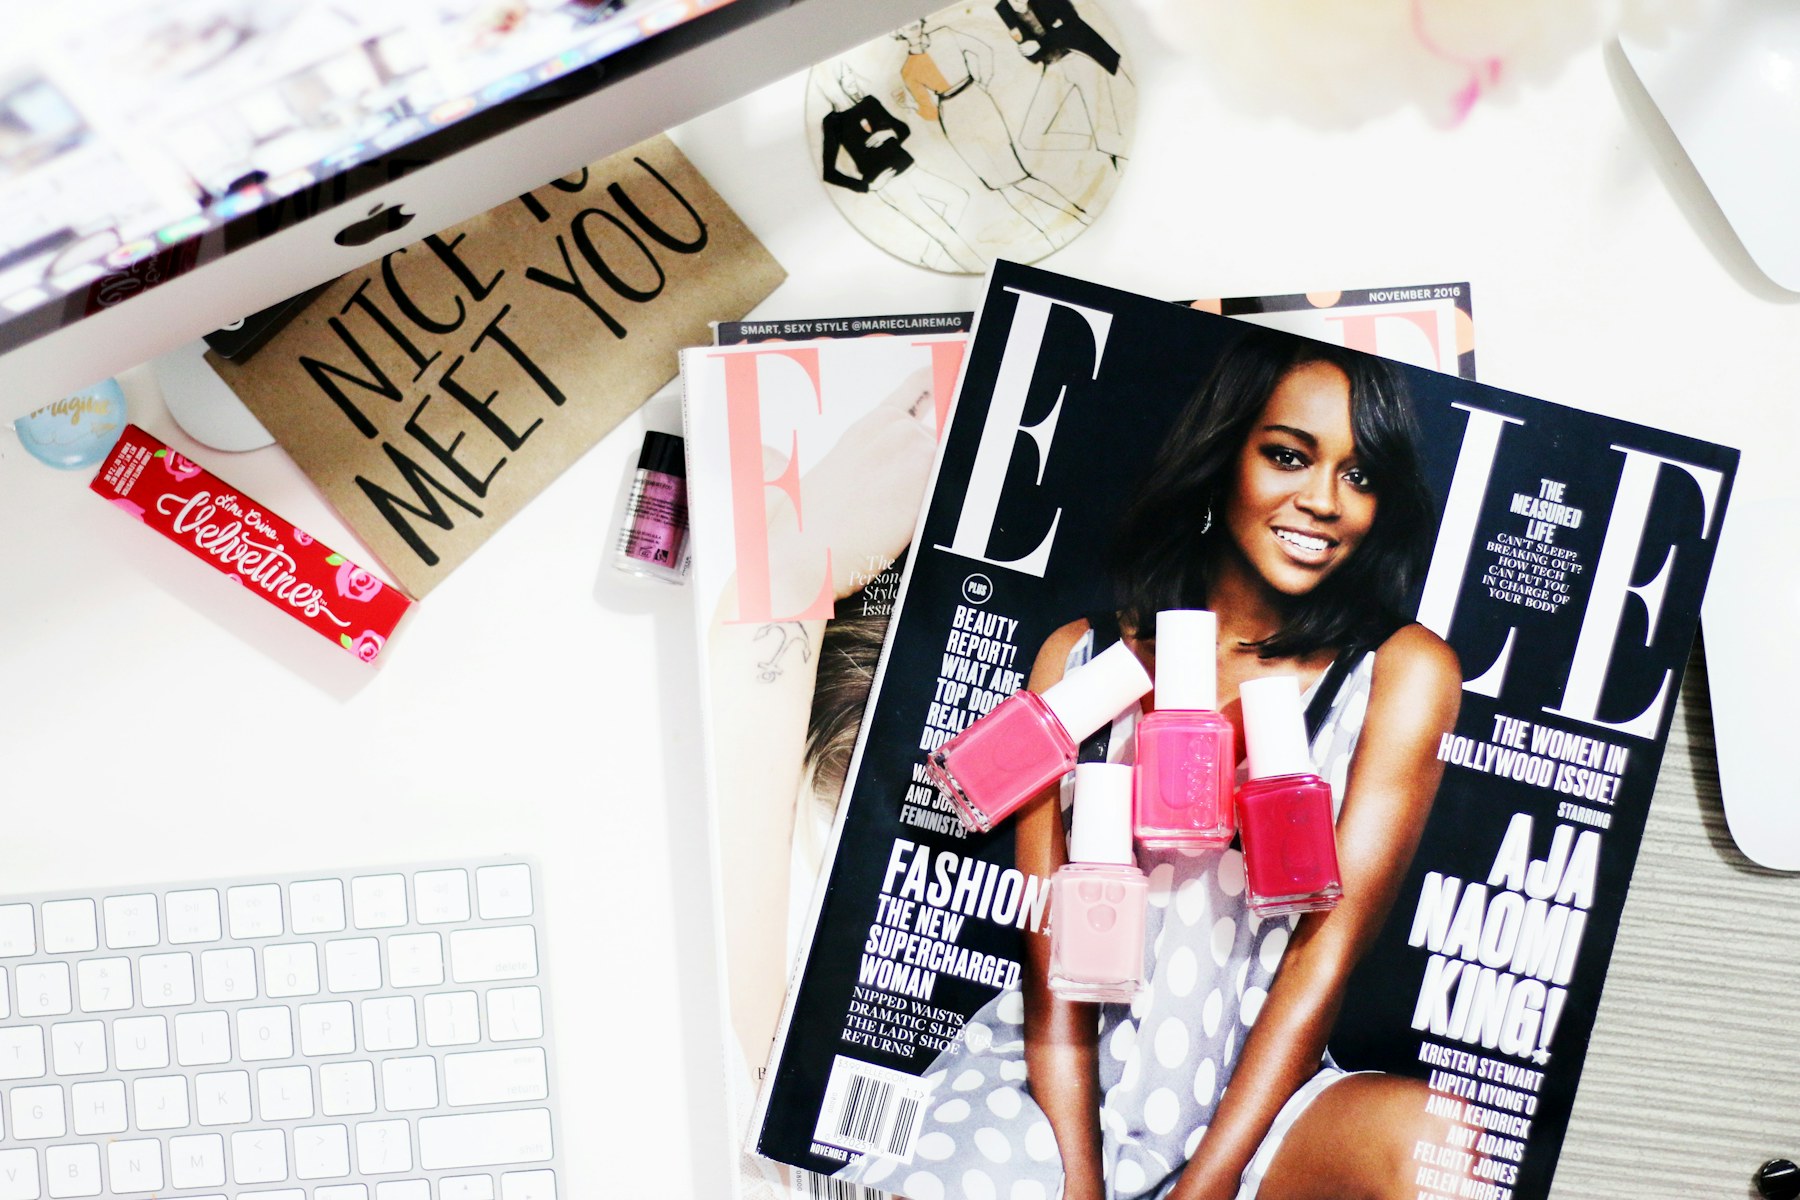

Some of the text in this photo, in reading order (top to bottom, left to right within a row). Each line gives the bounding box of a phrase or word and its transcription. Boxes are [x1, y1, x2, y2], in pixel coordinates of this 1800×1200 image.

[1369, 287, 1460, 302] NOVEMBER 2016
[300, 232, 504, 438] NICE
[741, 317, 962, 335] SMART, SEXY STYLE @MARIECLAIREMAG
[355, 157, 708, 566] MEET YOU
[1538, 478, 1566, 503] THE
[1510, 493, 1583, 529] MEASURED
[1526, 518, 1556, 544] LIFE
[156, 491, 351, 627] Velvetines
[1486, 542, 1582, 574] BREAKING OUT?
[1497, 532, 1578, 562] CAN'T SLEEP?
[866, 555, 895, 570] The
[1498, 556, 1565, 582] HOW TECH
[968, 582, 987, 596] PLUS
[1482, 574, 1570, 605] IN CHARGE OF
[1488, 565, 1570, 594] CAN PUT YOU
[1488, 588, 1559, 614] YOUR BODY
[952, 605, 1019, 642] BEAUTY
[946, 629, 1017, 668] REPORT!
[940, 653, 1024, 695] WHAT ARE
[934, 677, 968, 706] TOP
[1492, 714, 1629, 776] THE WOMEN IN
[1436, 732, 1622, 806] HOLLYWOOD ISSUE!
[904, 784, 932, 806] AND
[900, 804, 968, 839] FEMINISTS!
[1557, 802, 1612, 830] STARRING
[1486, 812, 1601, 910] AJA
[874, 894, 965, 943] THE NEW
[1408, 870, 1588, 986] NAOMI
[495, 961, 528, 973] delete
[865, 924, 1021, 991] SUPERCHARGED
[163, 982, 173, 997] 8
[225, 978, 234, 992] 9
[858, 954, 936, 1000] WOMAN
[39, 993, 49, 1007] 6
[102, 987, 110, 1000] 7
[852, 986, 966, 1028] NIPPED WAISTS,
[848, 1001, 926, 1030] DRAMATIC
[1410, 954, 1567, 1066] KING!
[259, 1026, 270, 1041] O
[321, 1022, 331, 1035] P
[846, 1015, 960, 1056] THE LADY SHOE
[12, 1046, 21, 1059] T
[74, 1042, 83, 1054] Y
[135, 1037, 146, 1051] U
[841, 1029, 916, 1058] RETURNS!
[1418, 1042, 1544, 1092] KRISTEN STEWART
[157, 1096, 165, 1110] J
[218, 1092, 227, 1104] K
[281, 1087, 290, 1101] L
[507, 1083, 540, 1095] return
[1428, 1070, 1538, 1116] LUPITA NYONG'O
[32, 1105, 43, 1120] G
[94, 1101, 105, 1114] H
[1424, 1094, 1532, 1139] ANNA KENDRICK
[519, 1144, 544, 1154] shift
[810, 1142, 848, 1162] NOVEMBER
[1446, 1124, 1525, 1162] AMY ADAMS
[6, 1168, 16, 1182] V
[68, 1164, 78, 1178] B
[129, 1160, 140, 1172] N
[190, 1155, 204, 1168] M
[1413, 1140, 1519, 1184] FELICITY JONES
[1416, 1166, 1512, 1200] HELEN MIRREN
